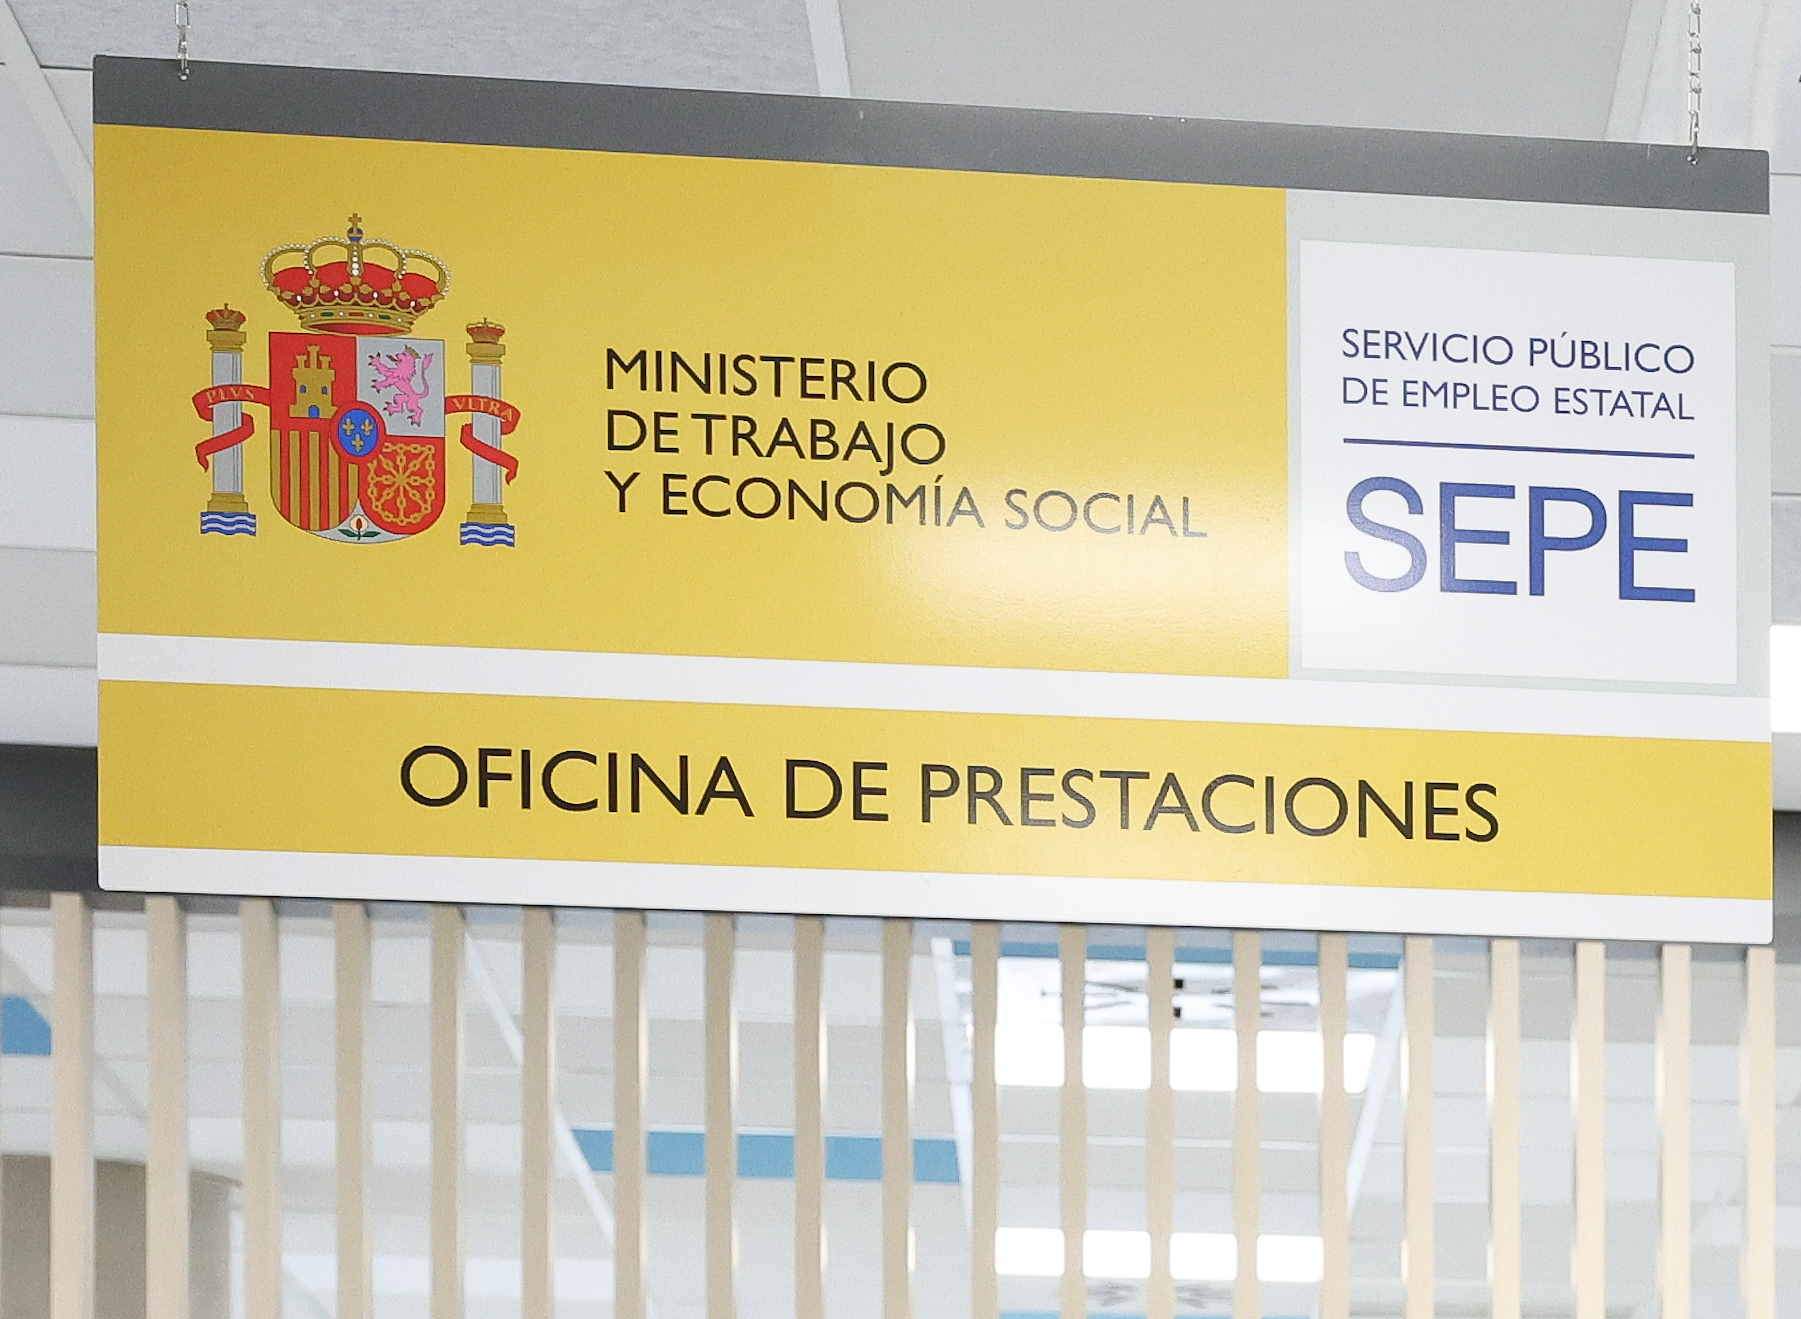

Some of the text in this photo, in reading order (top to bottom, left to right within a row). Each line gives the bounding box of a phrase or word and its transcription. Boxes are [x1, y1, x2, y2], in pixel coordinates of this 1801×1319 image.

[606, 347, 928, 404] MINISTERIO
[1341, 327, 1695, 375] SERVICIO PÚBLICO
[206, 386, 254, 403] PLVS
[453, 398, 512, 422] VLTRA
[1342, 376, 1696, 421] DE EMPLEO ESTATAL
[607, 408, 946, 477] DE TRABAJO
[603, 470, 1209, 538] Y ECONOMÍA SOCIAL
[1343, 475, 1697, 604] SEPE
[400, 745, 1499, 843] OFICINA DE PRESTACIONES
